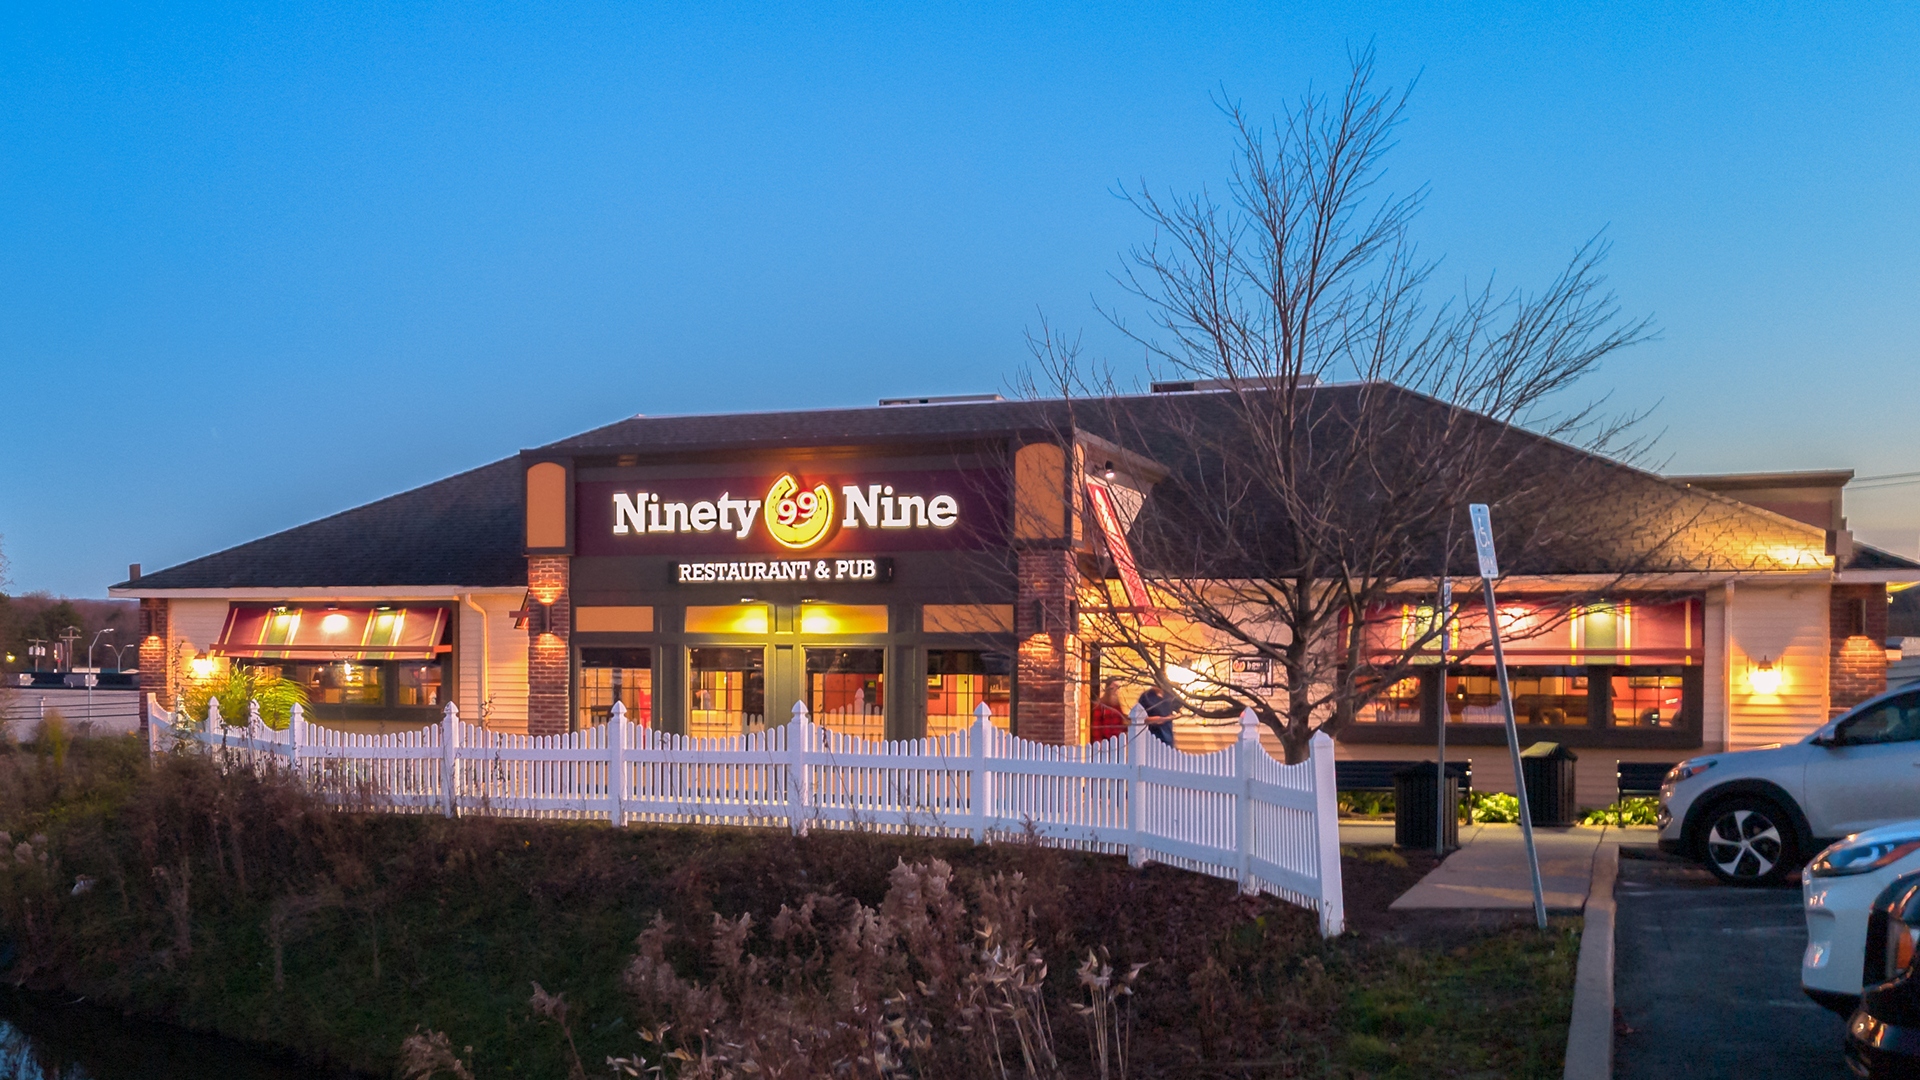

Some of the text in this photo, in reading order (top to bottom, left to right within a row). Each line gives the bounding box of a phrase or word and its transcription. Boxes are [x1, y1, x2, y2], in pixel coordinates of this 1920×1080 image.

[613, 485, 958, 539] Ninety 99 Nine
[678, 560, 876, 582] RESTAURANT & PUB
